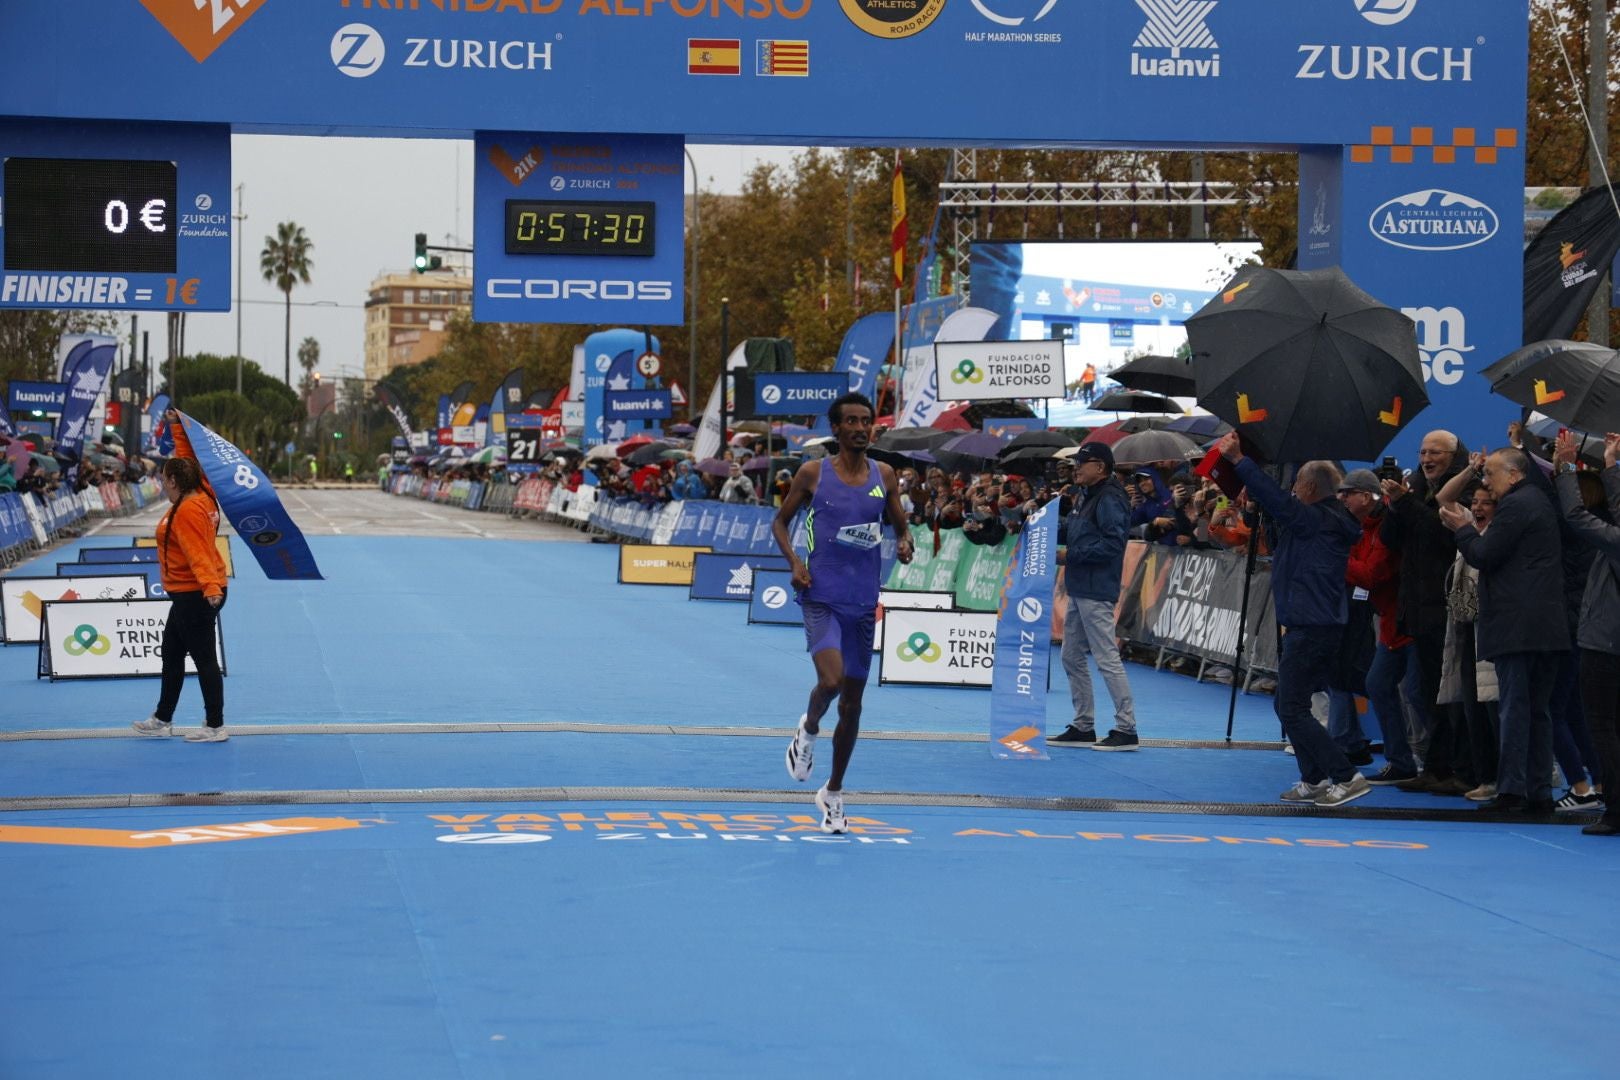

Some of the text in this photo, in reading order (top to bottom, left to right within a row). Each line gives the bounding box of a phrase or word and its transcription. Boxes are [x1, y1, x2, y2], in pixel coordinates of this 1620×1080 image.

[867, 0, 917, 9] ATHLETICS
[890, 4, 937, 33] ROAD RACE
[964, 32, 1062, 42] HALF MARATHON SERIES
[403, 38, 553, 70] ZURICH
[1130, 53, 1221, 77] luanvi
[1294, 44, 1474, 81] ZURICH
[513, 153, 538, 180] 21K
[569, 179, 611, 189] ZURICH
[104, 199, 166, 234] 0 €
[181, 214, 226, 225] ZURICH
[1443, 210, 1484, 218] LECHERA
[516, 211, 645, 244] 0:57:30
[1380, 211, 1489, 235] ASTURIANA
[178, 225, 229, 238] Foundation
[1, 275, 128, 304] FINISHER
[165, 278, 201, 305] 1€
[486, 278, 672, 300] COROS
[988, 363, 1051, 375] TRINIDAD
[988, 375, 1051, 387] ALFONSO
[16, 389, 56, 403] luanvi
[786, 388, 838, 400] ZURICH
[612, 399, 650, 411] luanvi
[510, 440, 537, 460] 21
[1029, 526, 1041, 576] TRINIDAD
[949, 628, 996, 639] FUNDA
[948, 655, 993, 669] ALFO
[1016, 630, 1035, 695] ZURICH
[424, 811, 892, 827] VALENCIA
[594, 831, 914, 846] ZURICH
[952, 828, 1431, 850] ALFONSO
